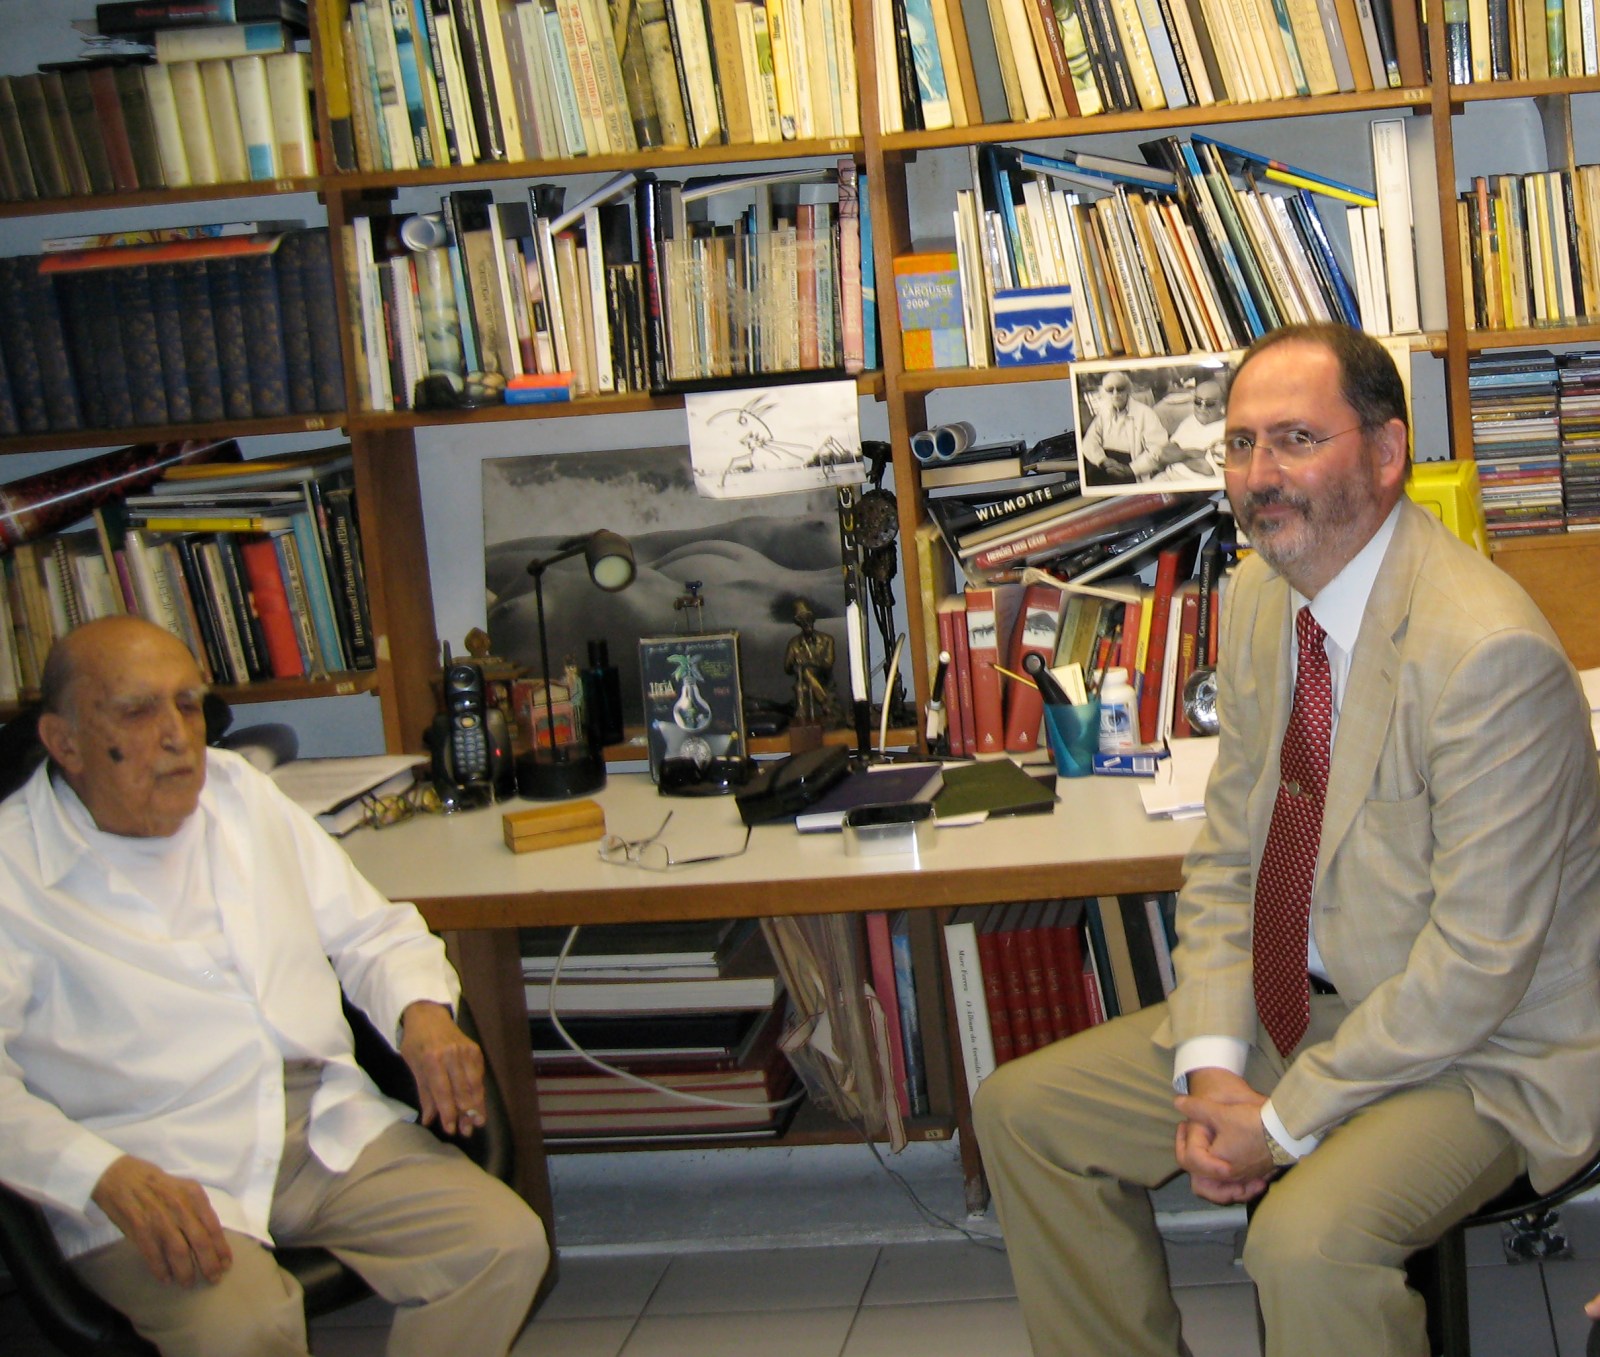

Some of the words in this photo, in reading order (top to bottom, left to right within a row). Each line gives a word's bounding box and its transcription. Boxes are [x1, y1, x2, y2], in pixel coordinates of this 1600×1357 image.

[902, 282, 953, 299] LAROUSSE
[976, 486, 1053, 522] WILMOTTE
[154, 568, 169, 613] VICENTE
